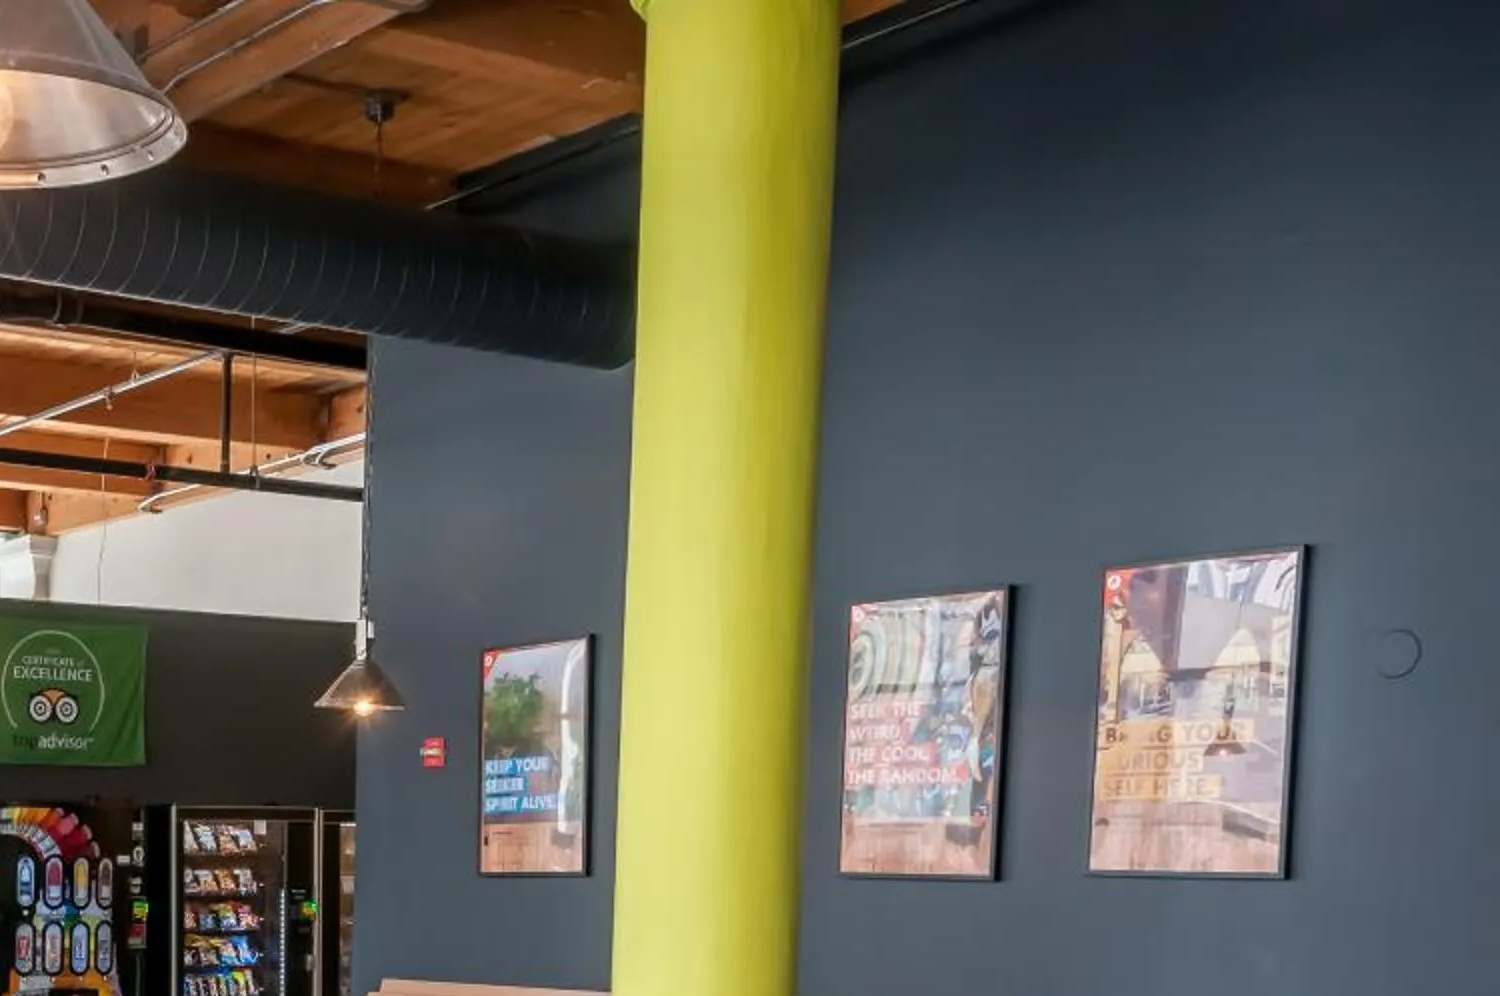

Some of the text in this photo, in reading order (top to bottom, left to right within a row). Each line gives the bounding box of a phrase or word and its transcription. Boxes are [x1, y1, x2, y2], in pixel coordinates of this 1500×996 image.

[13, 666, 93, 681] EXCELLENCE
[881, 745, 929, 761] COOL
[1104, 750, 1201, 771] URIOUS
[847, 769, 875, 785] THE
